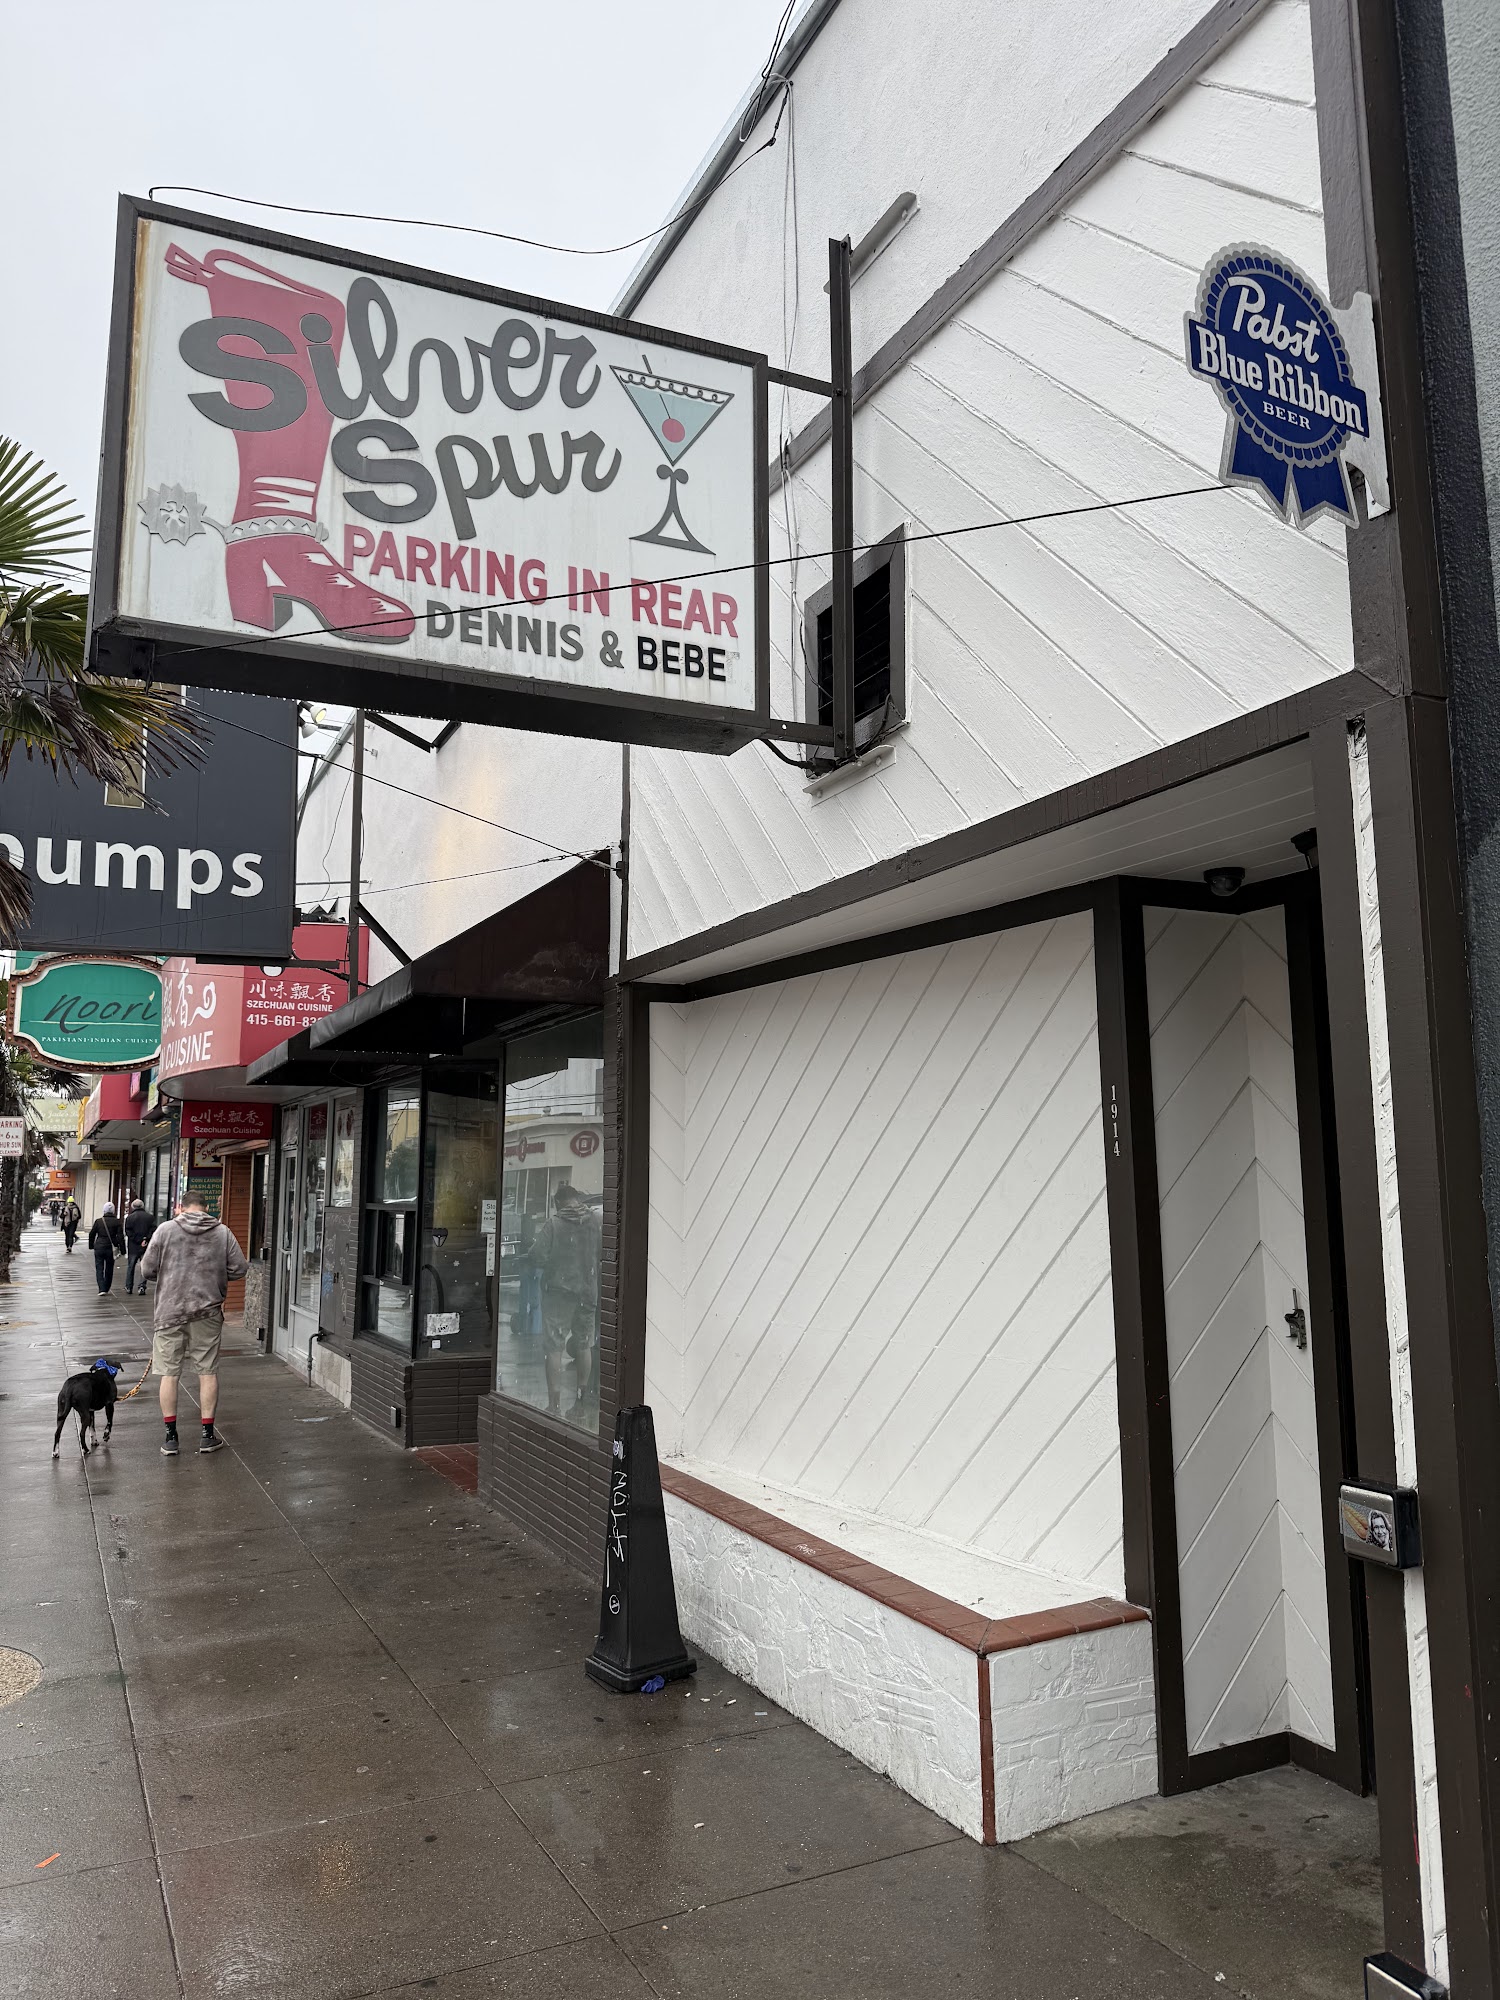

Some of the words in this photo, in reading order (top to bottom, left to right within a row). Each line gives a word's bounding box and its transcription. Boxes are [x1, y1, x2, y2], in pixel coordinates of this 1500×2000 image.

[178, 277, 601, 432] Silver
[1227, 275, 1320, 363] Pabst
[1196, 325, 1263, 391] Blue
[1265, 353, 1364, 432] Ribbon
[1262, 401, 1311, 430] BEER
[331, 419, 622, 540] Spur
[343, 524, 548, 605] PARKING
[568, 565, 610, 617] IN
[631, 578, 738, 637] REAR
[426, 600, 584, 661] DENNIS
[600, 630, 624, 668] &
[637, 636, 726, 681] BEBE
[0, 833, 264, 910] umps
[246, 1000, 295, 1010] SZECHUAN
[297, 1003, 333, 1012] CUISINE
[246, 1013, 323, 1028] 415-661-83
[165, 1030, 213, 1070] CUISINE
[0, 1120, 23, 1128] ARKING
[5, 1131, 11, 1139] 6
[194, 1126, 231, 1134] Szechuan
[233, 1126, 261, 1134] Cuisine
[1111, 1085, 1120, 1157] 1914
